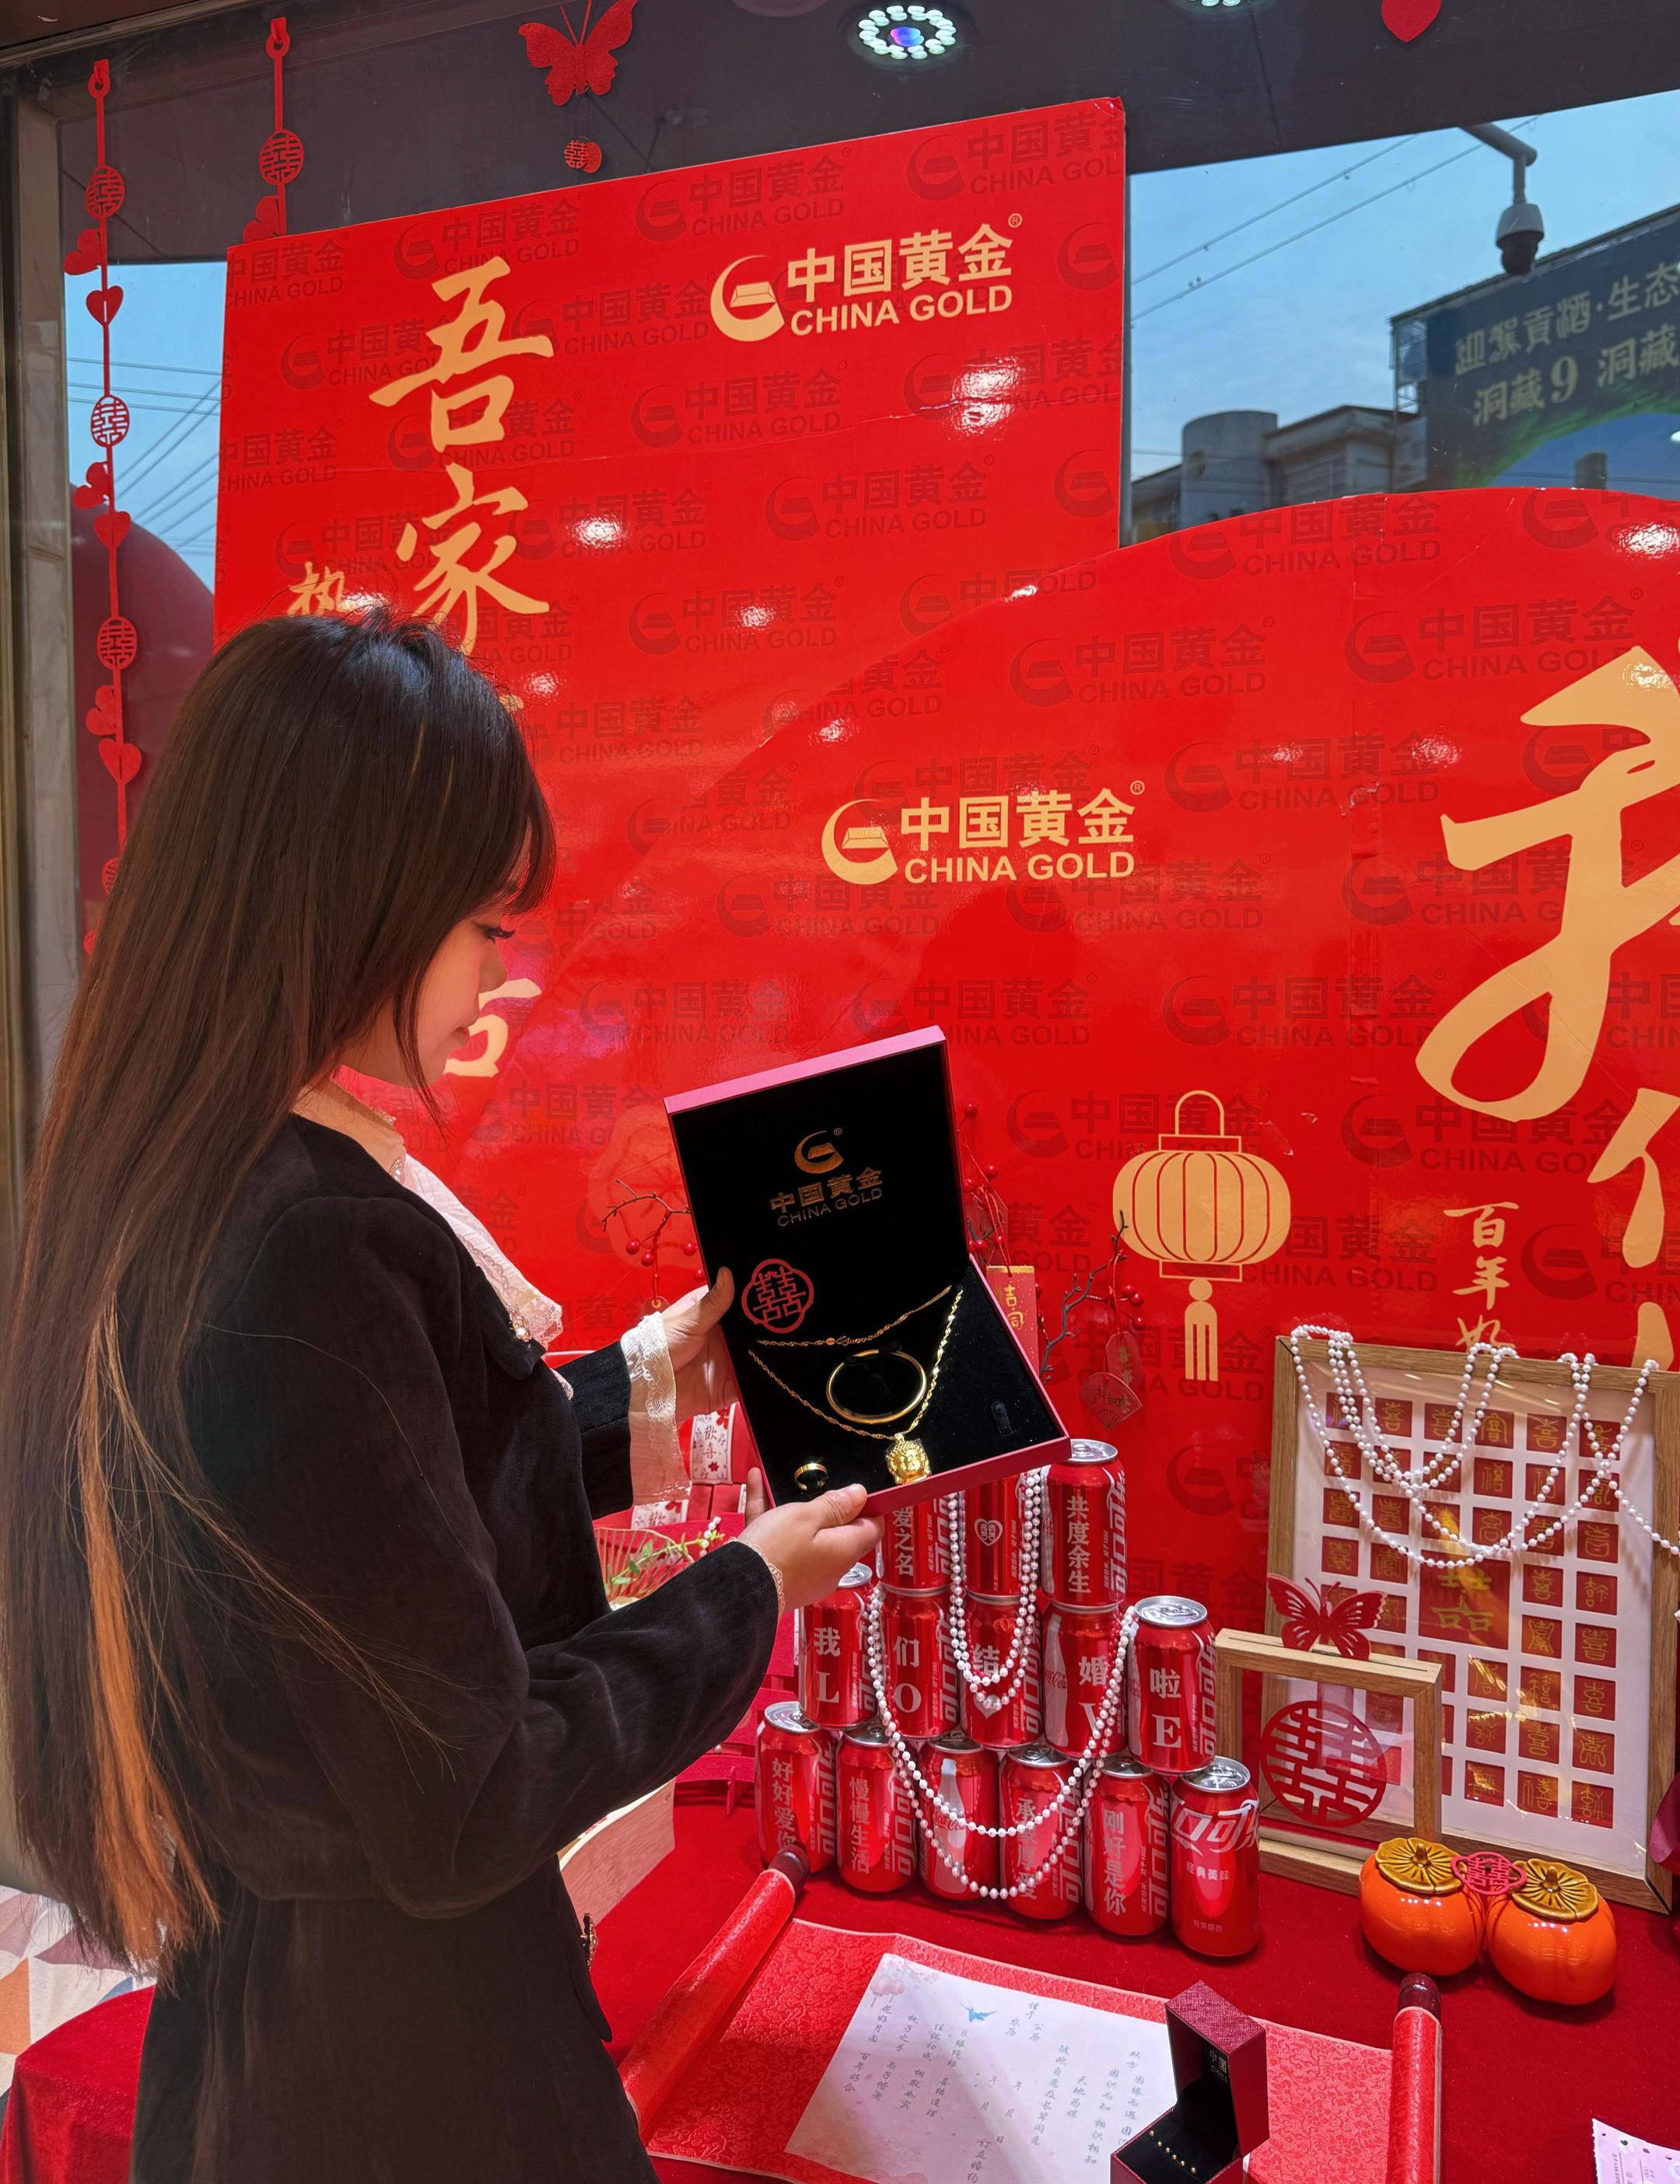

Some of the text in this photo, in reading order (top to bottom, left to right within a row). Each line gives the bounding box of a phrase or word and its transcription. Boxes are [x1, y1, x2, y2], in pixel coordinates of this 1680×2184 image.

[691, 159, 845, 213] 中国黄金
[970, 156, 1121, 195] CHINA GOL
[691, 198, 844, 236] CHINA GOLD
[516, 239, 580, 264] GOLD
[787, 223, 1013, 303] 中国黄金
[286, 276, 344, 300] GOLD
[562, 279, 709, 334] 中国黄金
[791, 285, 1013, 336] CHINA GOLD
[327, 316, 453, 364] 中国黄
[564, 320, 709, 355] CHINA GOLD
[327, 360, 391, 387] CHINA
[684, 366, 840, 420] 中国黄金
[1060, 382, 1119, 408] GOL
[688, 408, 840, 445] CHINA GOLD
[370, 257, 554, 661] 吾家
[511, 439, 575, 462] GOLD
[280, 465, 337, 486] GOLD
[822, 461, 987, 514] 中国黄金
[824, 507, 987, 541] CHINA GOLD
[639, 530, 706, 553] GOLD
[1243, 540, 1440, 576] CHINA GOLD
[684, 626, 837, 654] CHINA GOLD
[1418, 595, 1635, 653] 中国黄金
[1074, 623, 1268, 679] 中国黄金
[1422, 653, 1526, 681] CHINA
[866, 691, 942, 719] GOLD
[1078, 671, 1267, 706] CHINA GOLD
[1238, 786, 1339, 811] CHINA
[901, 787, 1134, 852] 中国黄金
[905, 851, 1135, 884] CHINA GOLD
[1075, 908, 1262, 934] CHINA GOLD
[1421, 901, 1527, 926] CHINA
[912, 976, 1090, 1021] 中国黄金
[1230, 972, 1438, 1023] 中国黄金
[1008, 1024, 1090, 1047] GOLD
[1235, 1024, 1337, 1048] CHINA
[1420, 1147, 1526, 1174] CHINA
[769, 1167, 884, 1214] 中国黄金
[777, 1187, 883, 1227] CHINA GOLD
[1346, 1266, 1437, 1293] GOLD
[1066, 1496, 1091, 1594] 共度余生
[814, 1626, 841, 1657] 我
[894, 1636, 920, 1668] 们
[972, 1643, 1000, 1676] 结
[1078, 1655, 1108, 1687] 婚
[819, 1671, 839, 1704] L
[894, 1682, 921, 1713] O
[1150, 1668, 1181, 1699] 啦
[1152, 1713, 1182, 1748] E
[849, 1776, 870, 1874] 慢慢生活
[1102, 1808, 1127, 1917] 刚好是你
[1186, 1860, 1230, 1881] 经典美味
